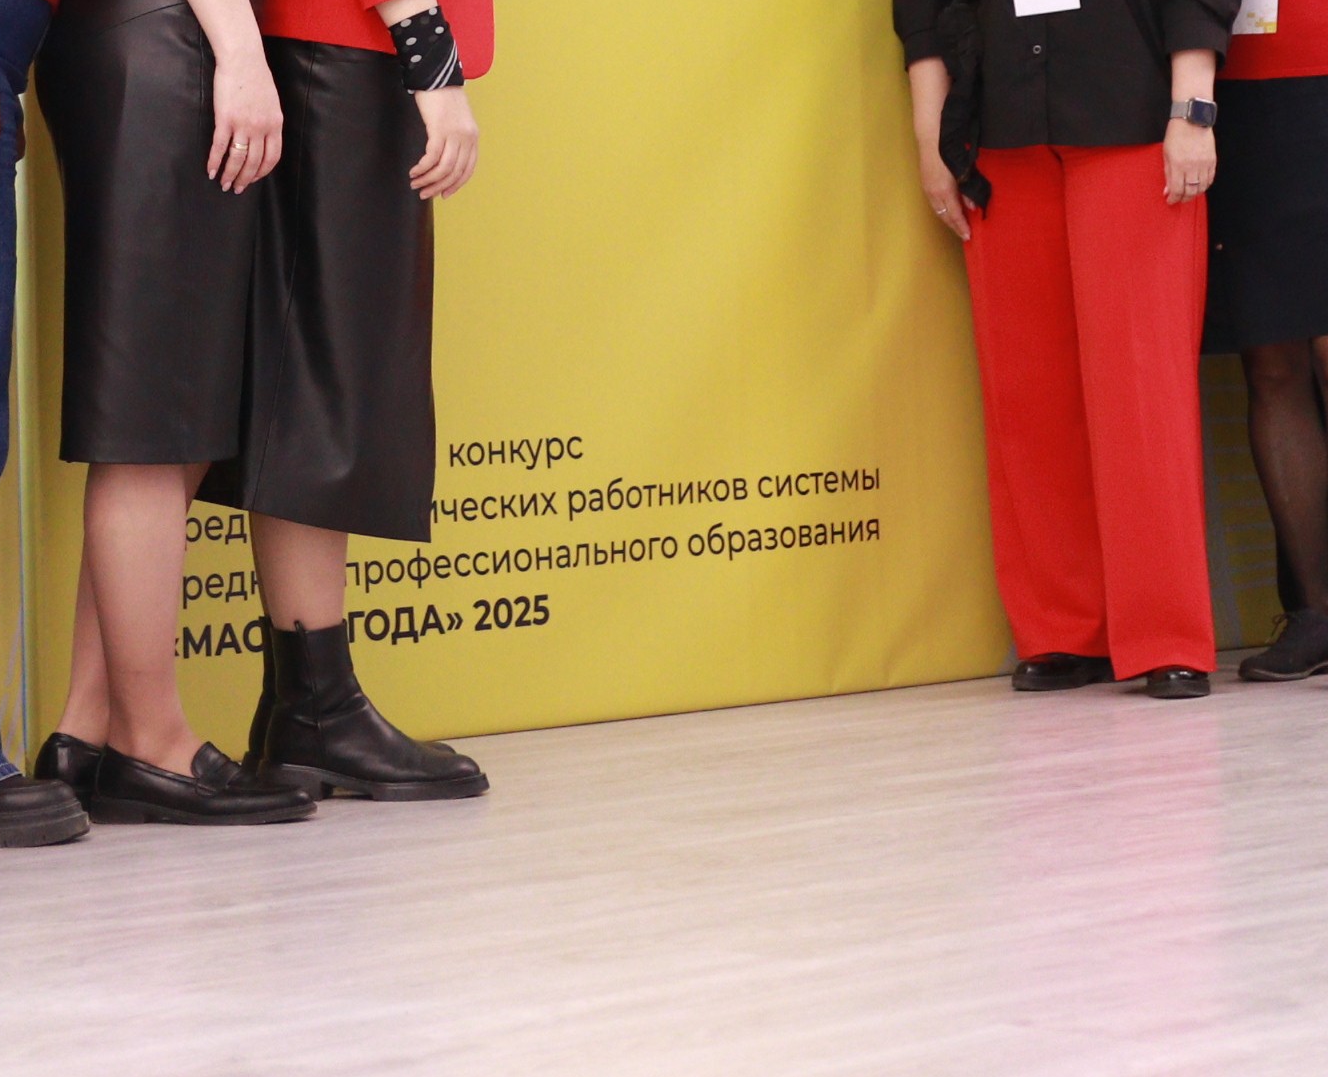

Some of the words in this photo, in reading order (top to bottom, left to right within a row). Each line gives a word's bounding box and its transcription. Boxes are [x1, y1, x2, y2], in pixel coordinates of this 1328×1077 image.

[449, 435, 584, 471] конкурс
[568, 477, 748, 522] работников
[758, 468, 880, 499] системы
[346, 536, 678, 594] профессионального
[688, 518, 880, 561] образования
[347, 606, 464, 646] ГОДА»
[473, 594, 551, 632] 2025
